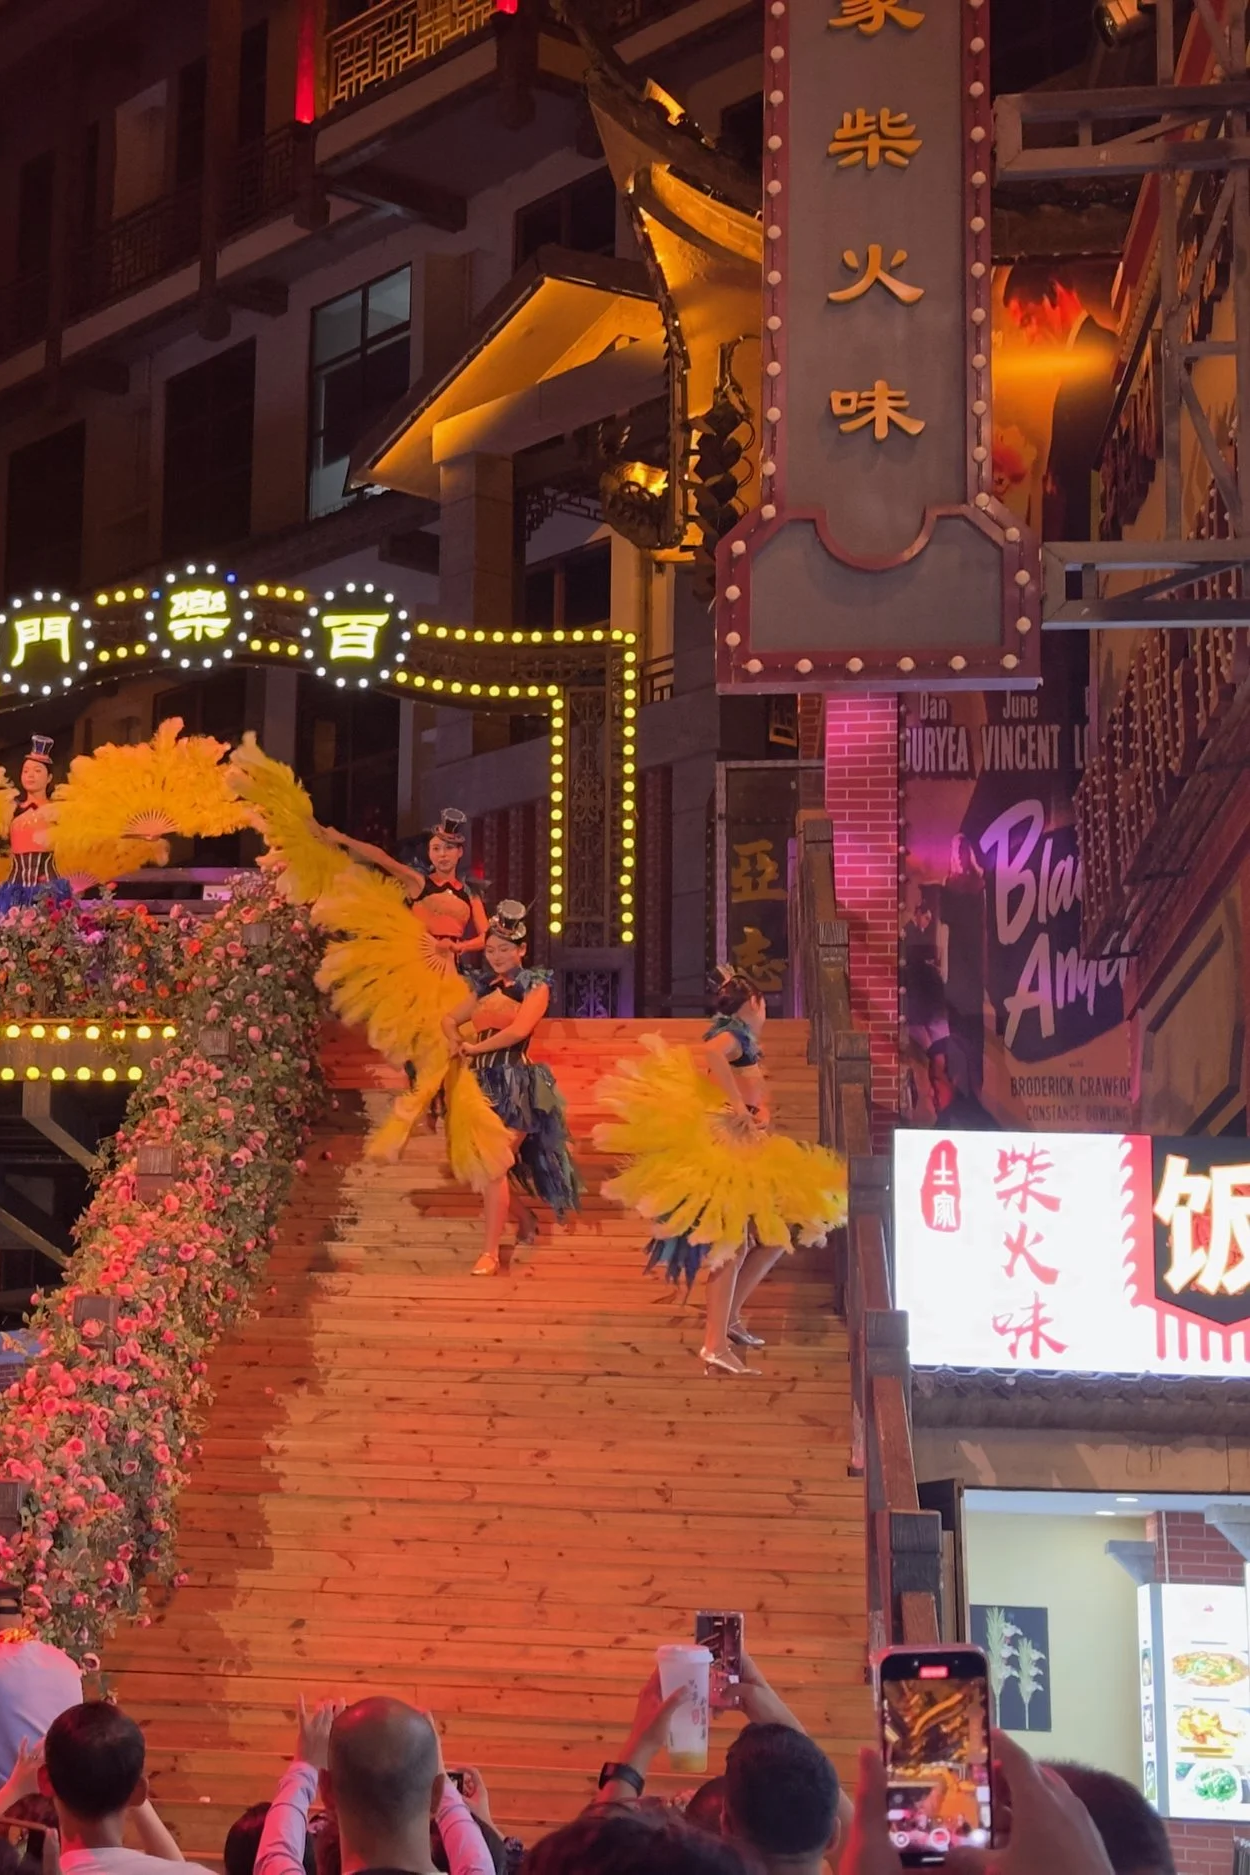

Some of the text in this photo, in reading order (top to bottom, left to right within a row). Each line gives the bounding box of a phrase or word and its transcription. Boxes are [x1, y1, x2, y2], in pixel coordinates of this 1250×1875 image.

[919, 691, 1039, 720] Dan June
[980, 724, 1062, 772] VINCENT
[1010, 1075, 1132, 1099] BRODERICK CRAWFO
[1026, 1103, 1080, 1122] CONSTANCE
[991, 1142, 1069, 1361] 柴火味
